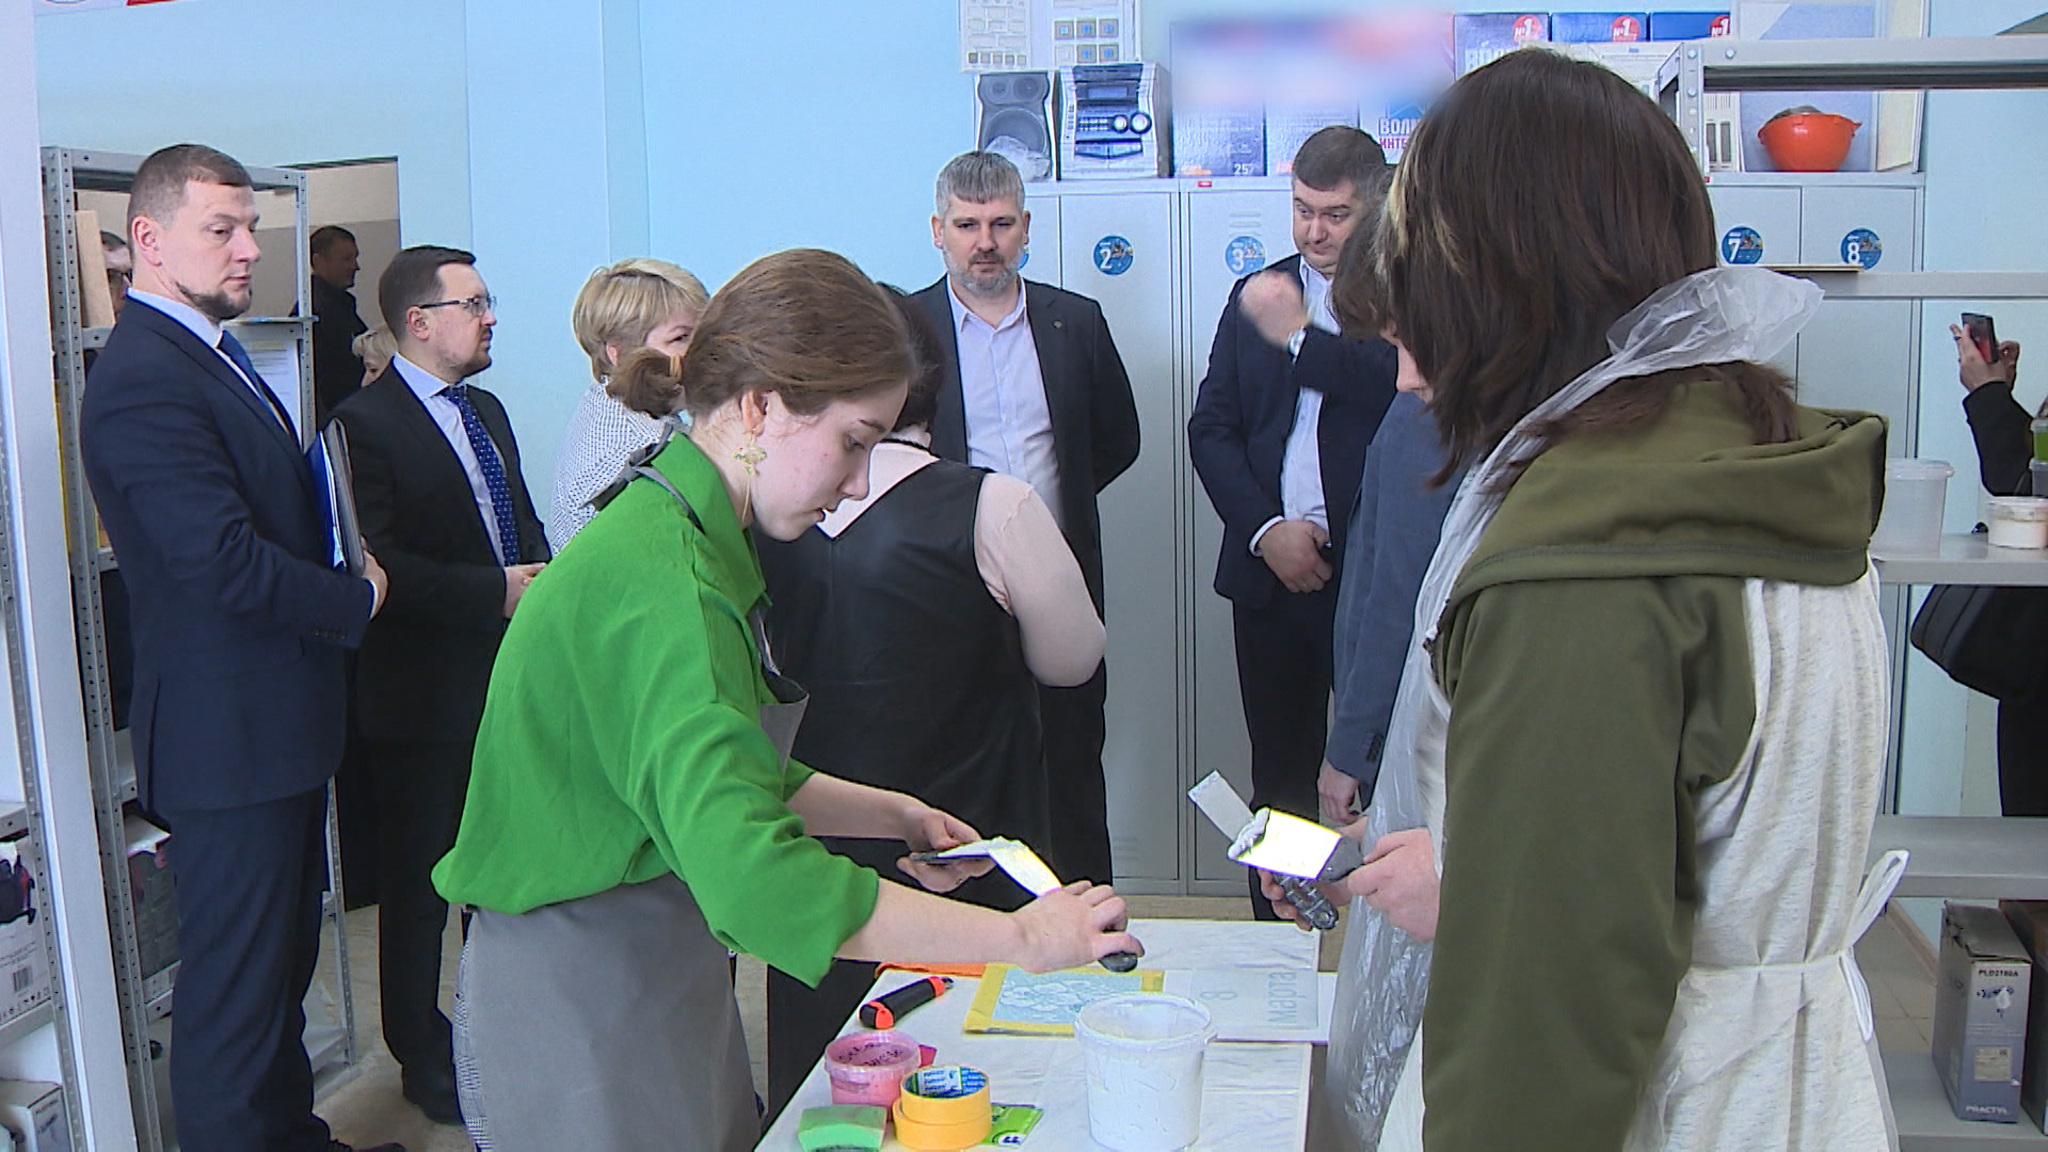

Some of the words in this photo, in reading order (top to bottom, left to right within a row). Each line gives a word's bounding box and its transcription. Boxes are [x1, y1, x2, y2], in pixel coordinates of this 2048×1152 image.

[1100, 249, 1112, 269] 2
[1232, 249, 1244, 270] 3
[1728, 238, 1741, 262] 7
[1848, 241, 1860, 264] 8
[1268, 971, 1306, 1024] марта
